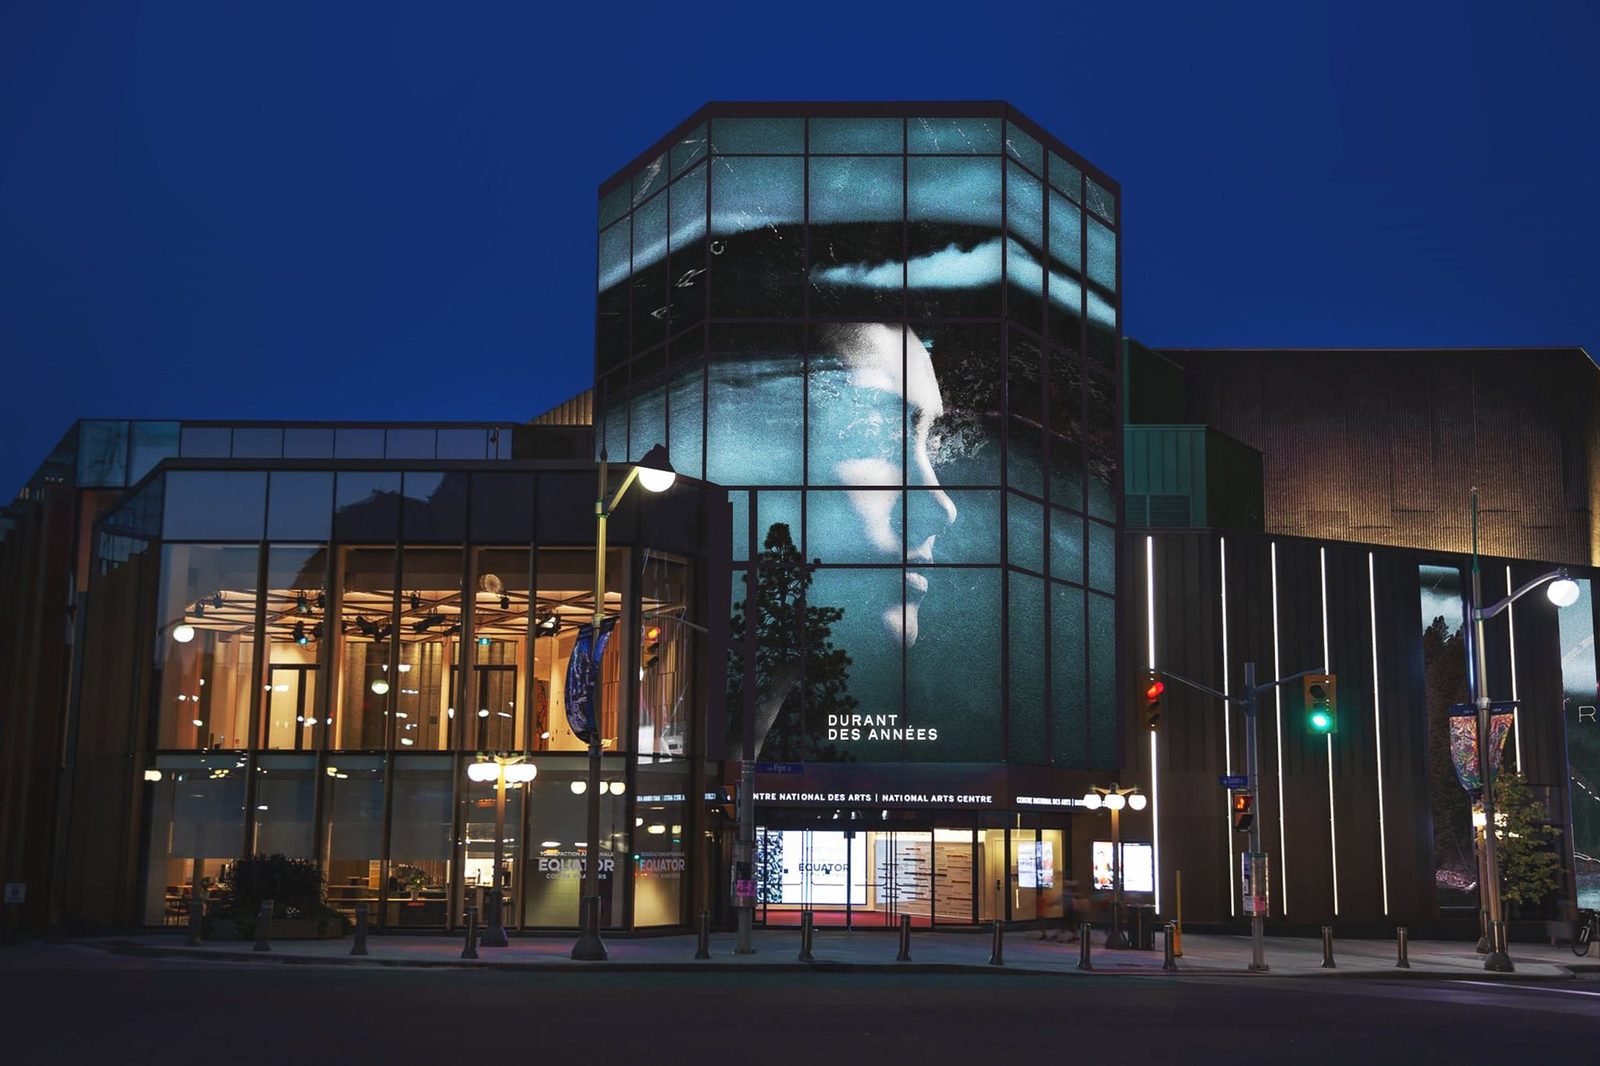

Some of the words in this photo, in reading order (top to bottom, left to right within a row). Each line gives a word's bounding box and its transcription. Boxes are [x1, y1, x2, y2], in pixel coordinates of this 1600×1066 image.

[828, 714, 898, 727] DURANT
[828, 728, 861, 741] DES
[867, 725, 938, 741] ANNÉES
[752, 793, 777, 801] NTRE
[779, 793, 825, 801] NATIONAL
[828, 793, 846, 801] DES
[848, 794, 872, 802] ARTS
[882, 794, 929, 802] NATIONAL
[930, 794, 955, 802] ARTS
[957, 795, 992, 803] CENTRE
[640, 858, 686, 872] EQUATOR
